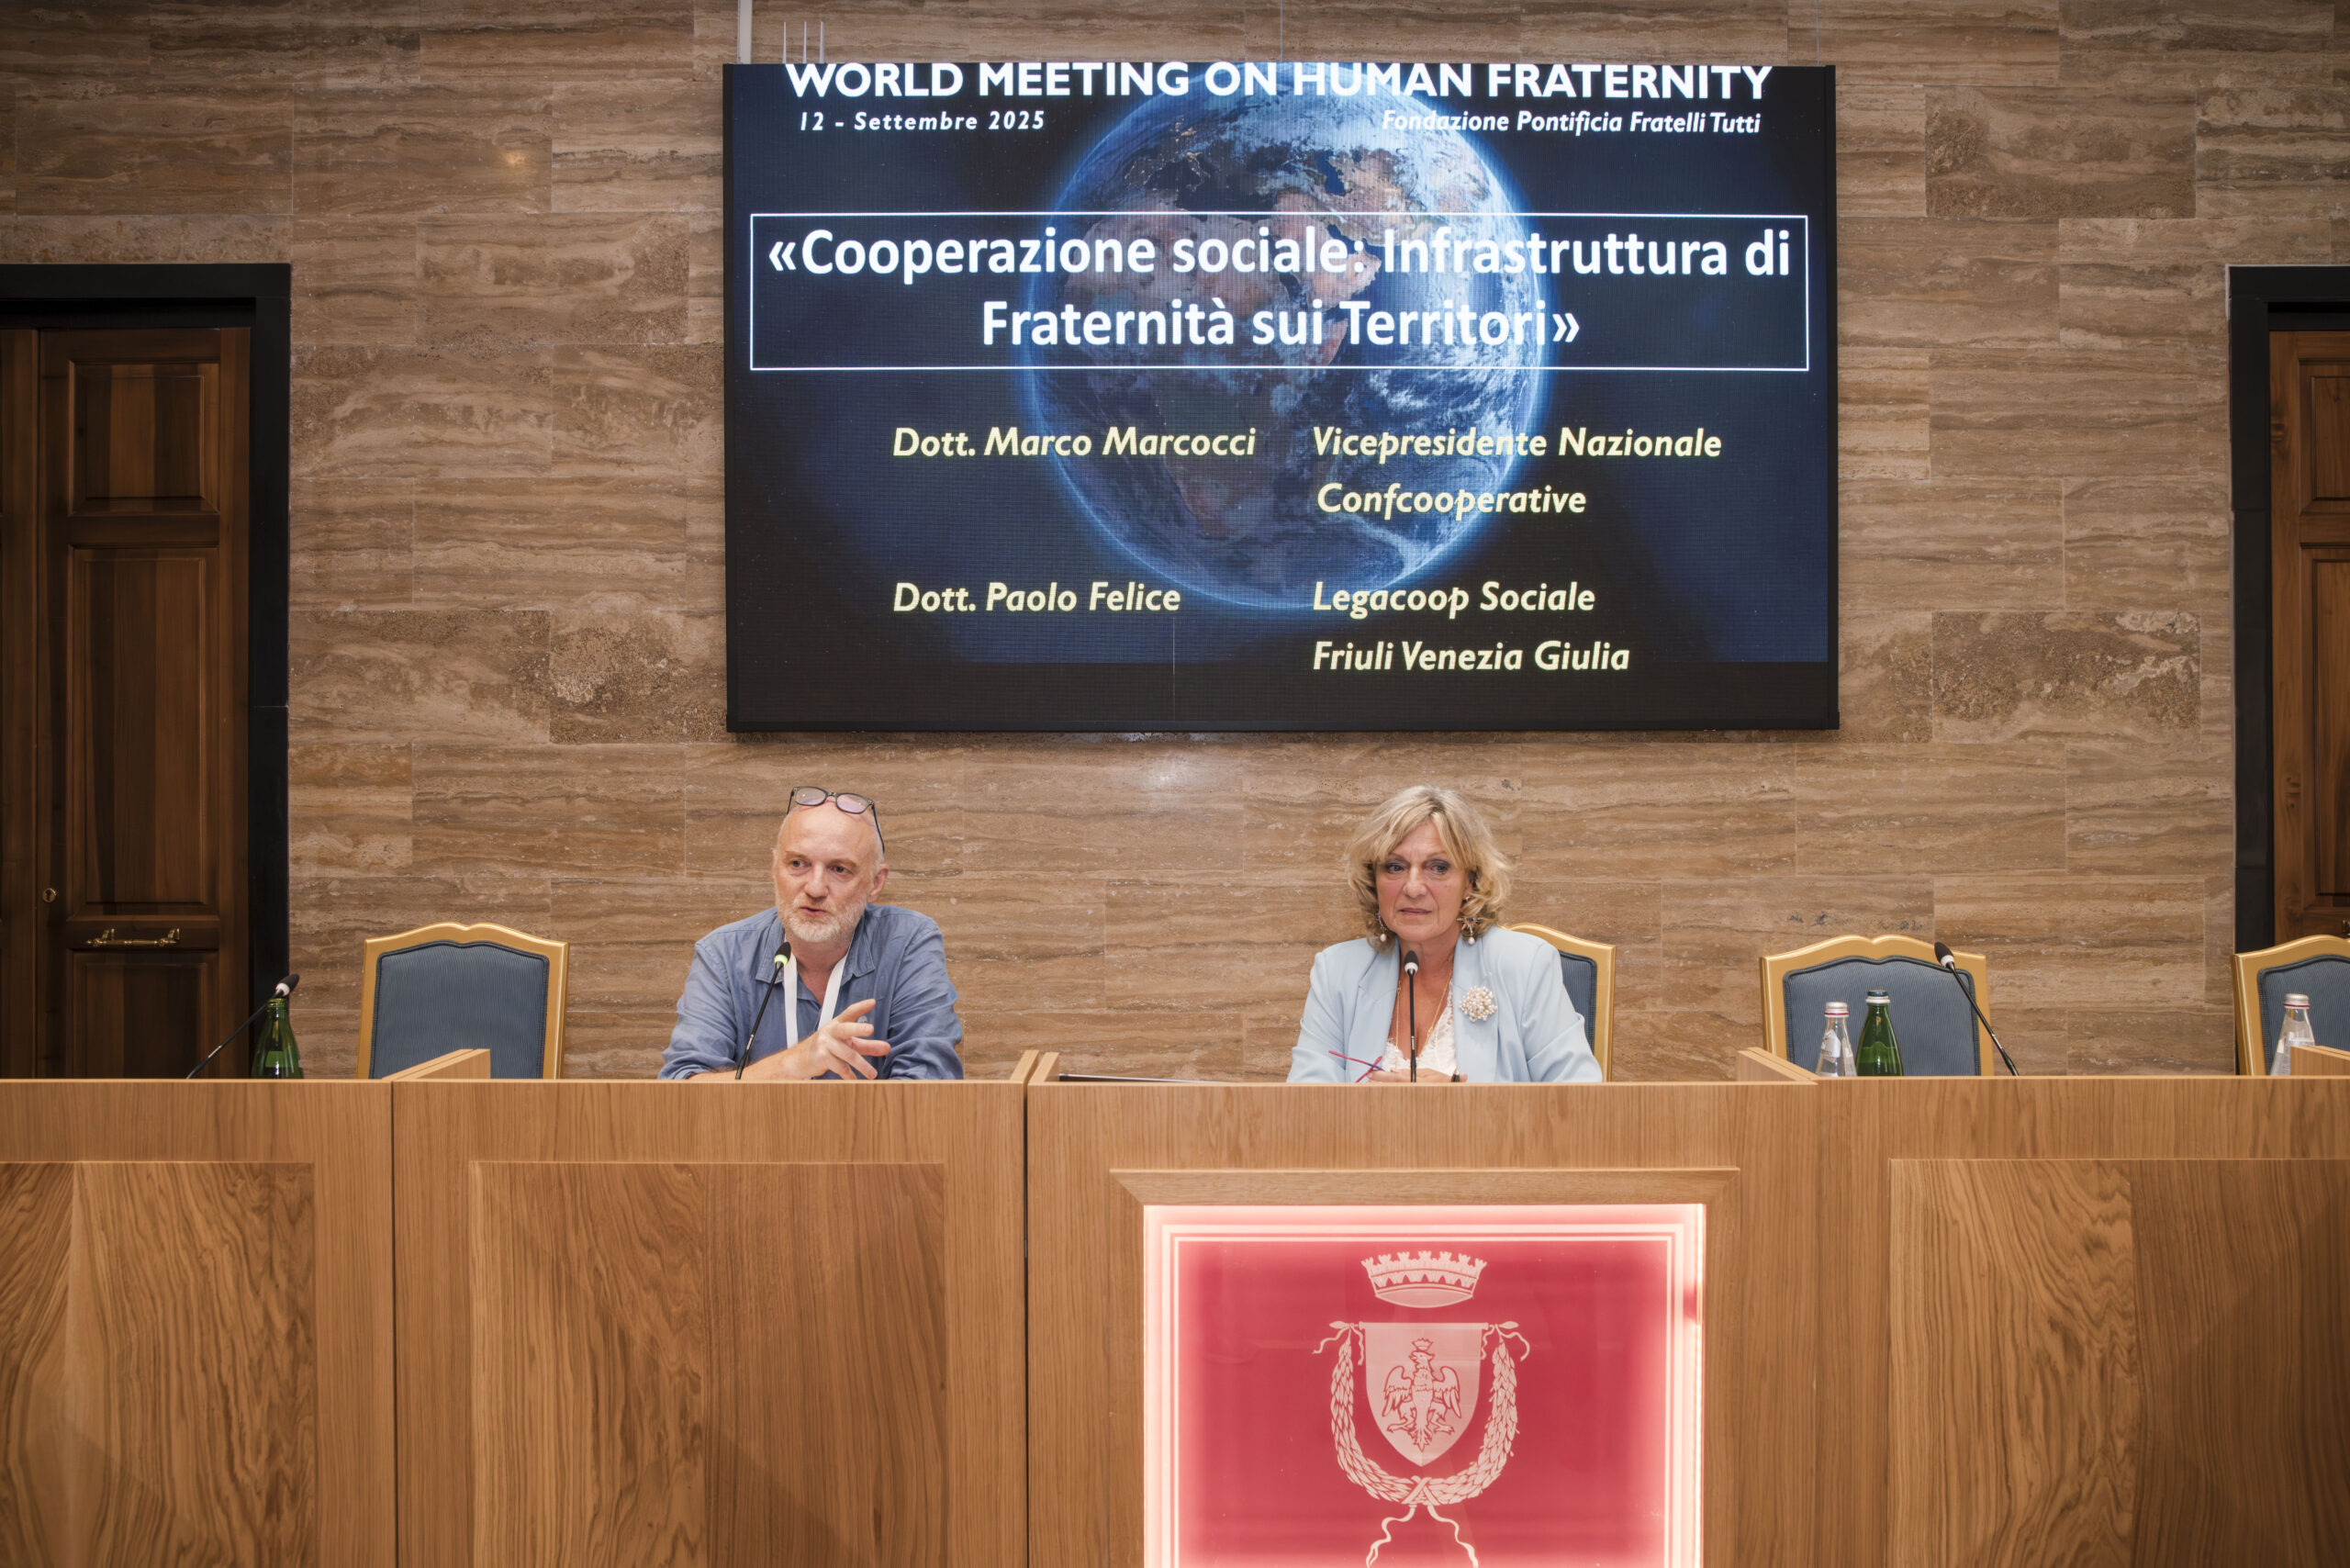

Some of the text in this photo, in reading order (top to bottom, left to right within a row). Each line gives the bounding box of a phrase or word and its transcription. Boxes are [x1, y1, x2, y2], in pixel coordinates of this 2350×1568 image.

[785, 62, 1773, 99] WORLD MEETING ON HUMAN FRATERNITY
[800, 110, 824, 131] 12
[854, 110, 978, 131] Settembre
[988, 109, 1046, 131] 2025
[1382, 109, 1762, 137] Fondazione Pontificia Fratelli Tutti
[768, 226, 1790, 285] «Cooperazione sociale: Infrastruttura di
[983, 297, 1580, 346] Fraternità sui Territori»
[892, 426, 1257, 457] Dott. Marco Marcocci
[1313, 426, 1722, 464] Vicepresidente Nazionale
[1317, 482, 1586, 521] Confcooperative
[893, 581, 1181, 612] Dott. Paolo Felice
[1313, 580, 1595, 620] Legacoop Sociale
[1313, 640, 1630, 671] Friuli Venezia Giulia
